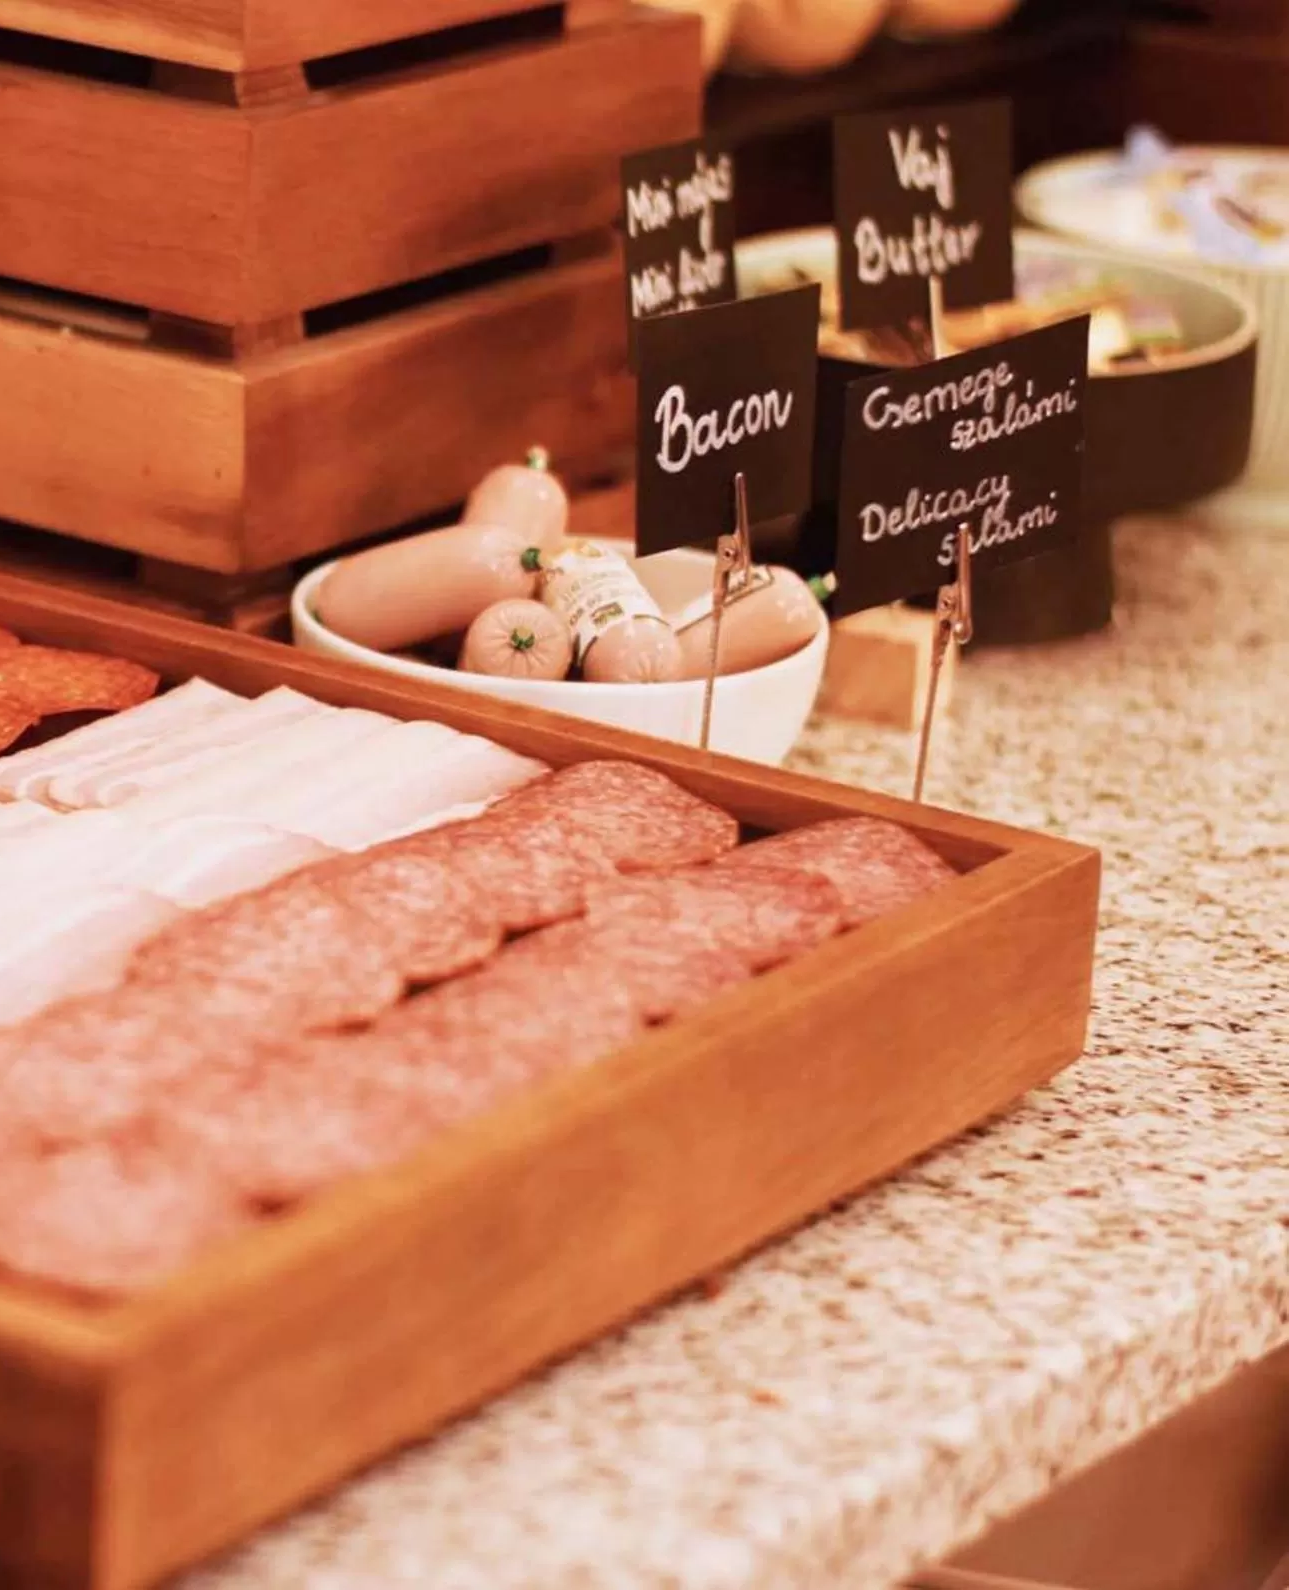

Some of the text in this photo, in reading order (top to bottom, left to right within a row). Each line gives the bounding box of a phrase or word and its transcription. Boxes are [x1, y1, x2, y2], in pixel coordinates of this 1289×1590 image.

[889, 122, 955, 210] Vaj
[626, 176, 674, 237] Mini
[854, 213, 982, 284] Butter
[630, 262, 674, 318] Mini
[654, 384, 792, 473] Bacon
[863, 361, 1014, 430] Csemege
[949, 378, 1077, 450] szalámi
[859, 475, 1013, 543] Delicacy
[937, 491, 1058, 566] slami
